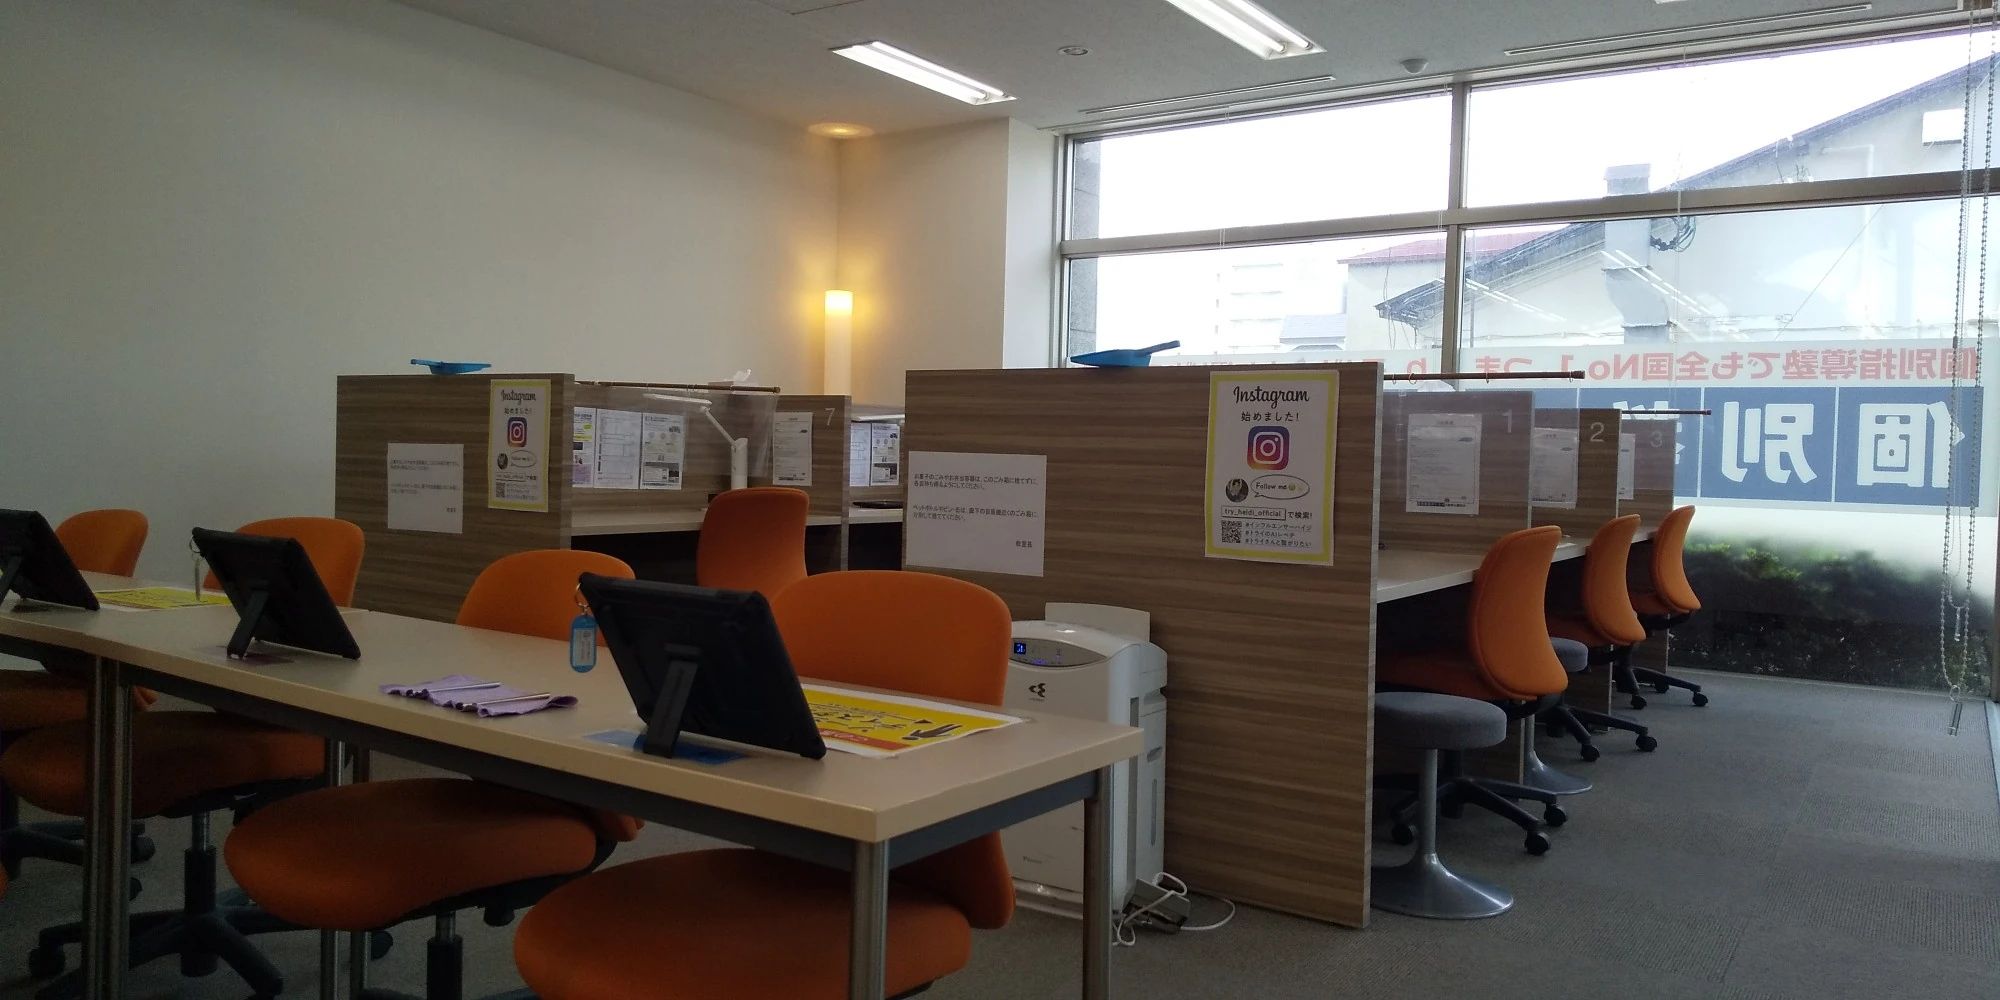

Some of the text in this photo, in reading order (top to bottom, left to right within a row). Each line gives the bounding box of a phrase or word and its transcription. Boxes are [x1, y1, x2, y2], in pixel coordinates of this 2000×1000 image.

[500, 389, 537, 406] Instagram
[1233, 386, 1310, 409] Instagram
[825, 407, 836, 426] 7
[1241, 411, 1299, 422] 始めました!
[1502, 408, 1513, 434] 1
[1589, 422, 1605, 443] 2
[1651, 430, 1663, 448] 3
[1255, 482, 1276, 490] Follow
[1224, 508, 1281, 518] try_heidi_official
